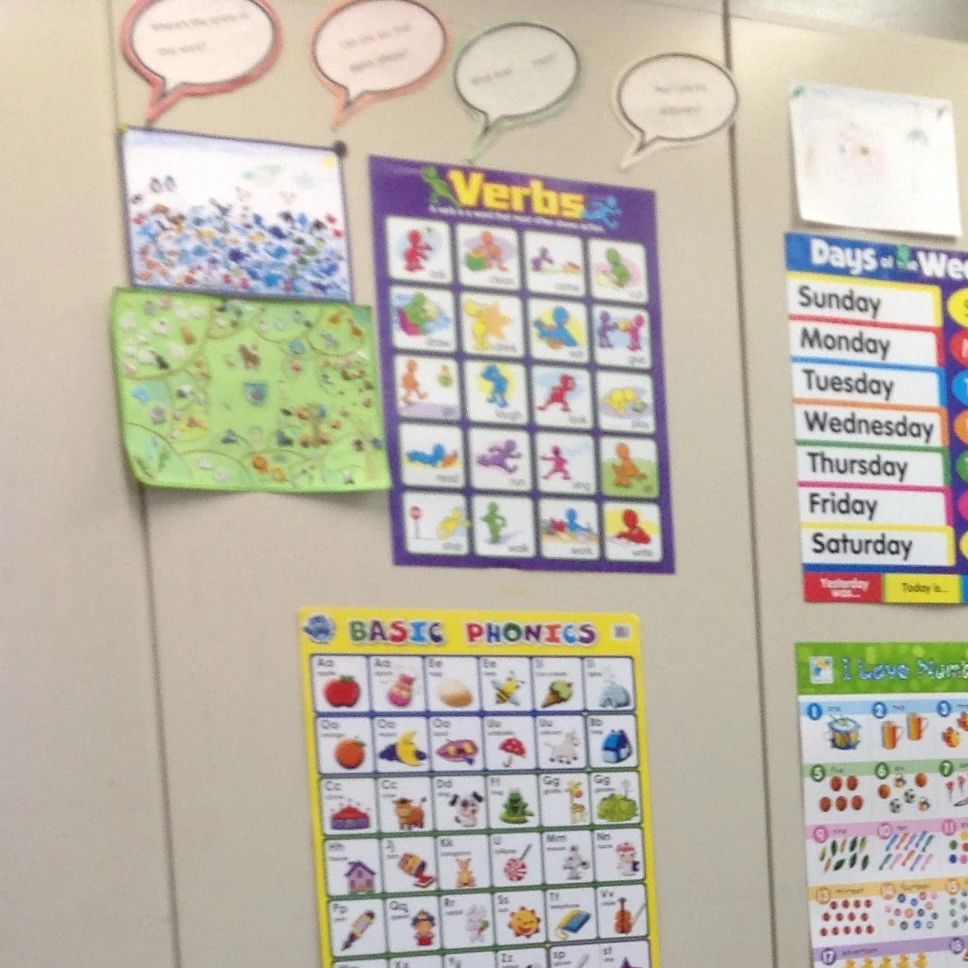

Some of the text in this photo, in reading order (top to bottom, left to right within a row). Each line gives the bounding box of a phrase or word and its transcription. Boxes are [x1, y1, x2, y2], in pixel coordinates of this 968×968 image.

[447, 170, 585, 219] Verbs
[809, 238, 877, 275] Days
[798, 285, 880, 319] Sunday
[800, 327, 891, 360] Monday
[803, 369, 894, 401] Tuesday
[805, 410, 934, 443] Wednesday
[807, 452, 908, 482] Thursday
[809, 492, 878, 520] Friday
[811, 532, 913, 560] Saturday
[902, 582, 930, 595] Today
[350, 620, 444, 643] BASIC
[465, 622, 597, 643] PHONICS
[858, 656, 909, 680] Love
[324, 781, 341, 791] Cc
[381, 780, 398, 789] Cc
[543, 776, 560, 787] Gg
[594, 774, 610, 785] Gg
[333, 903, 348, 913] Pp
[389, 901, 409, 913] Qq
